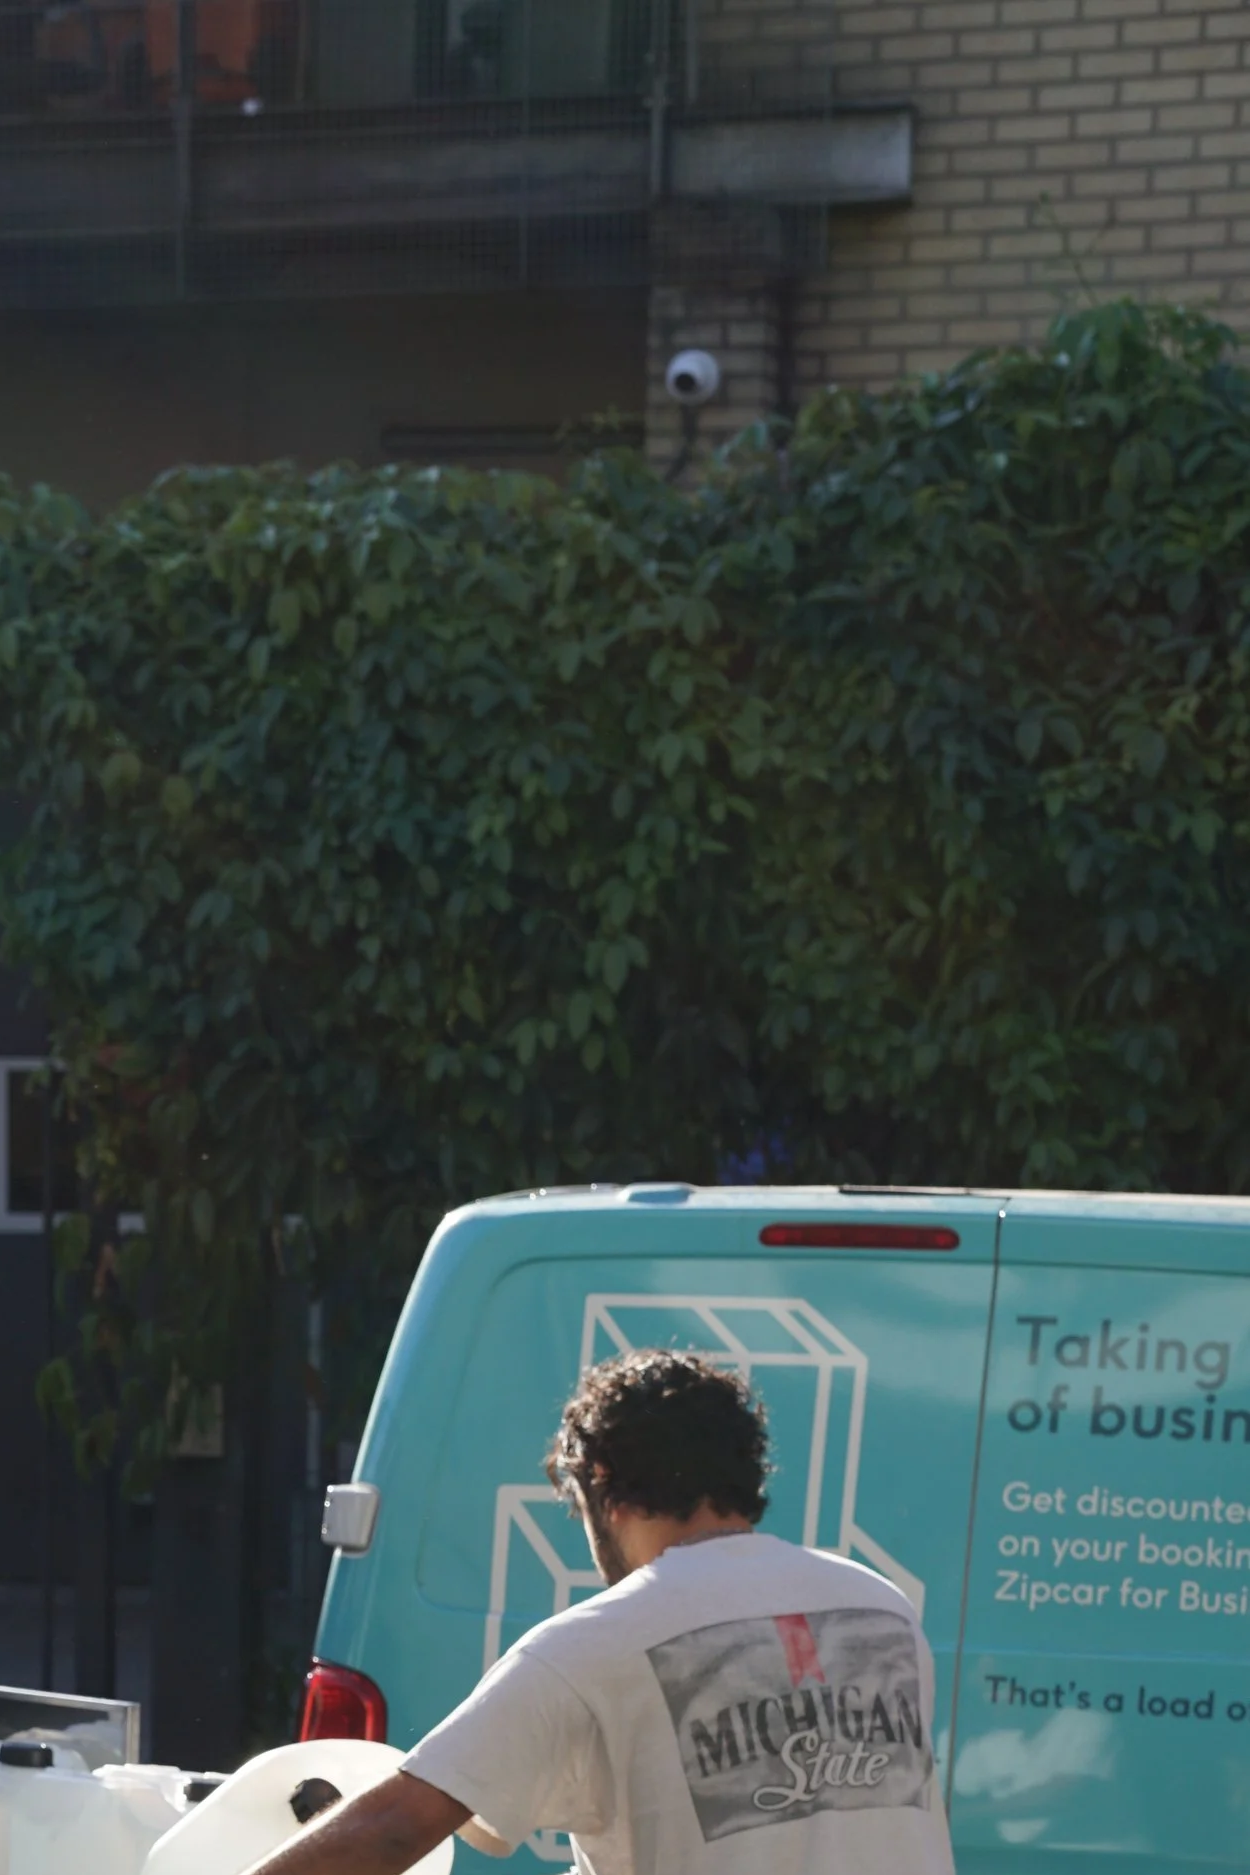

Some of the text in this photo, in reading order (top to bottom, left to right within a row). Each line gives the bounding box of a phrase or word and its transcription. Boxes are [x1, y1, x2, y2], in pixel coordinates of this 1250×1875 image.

[1016, 1315, 1232, 1390] Taking
[1008, 1383, 1250, 1443] of busin
[1002, 1480, 1250, 1523] Get discounte
[998, 1533, 1250, 1568] on your bookin
[995, 1570, 1110, 1612] Zipcar
[1120, 1578, 1168, 1609] for
[984, 1675, 1091, 1711] That's
[1103, 1693, 1123, 1713] a
[1137, 1686, 1215, 1719] load
[690, 1685, 923, 1778] MICHIGAN
[753, 1729, 889, 1811] State
